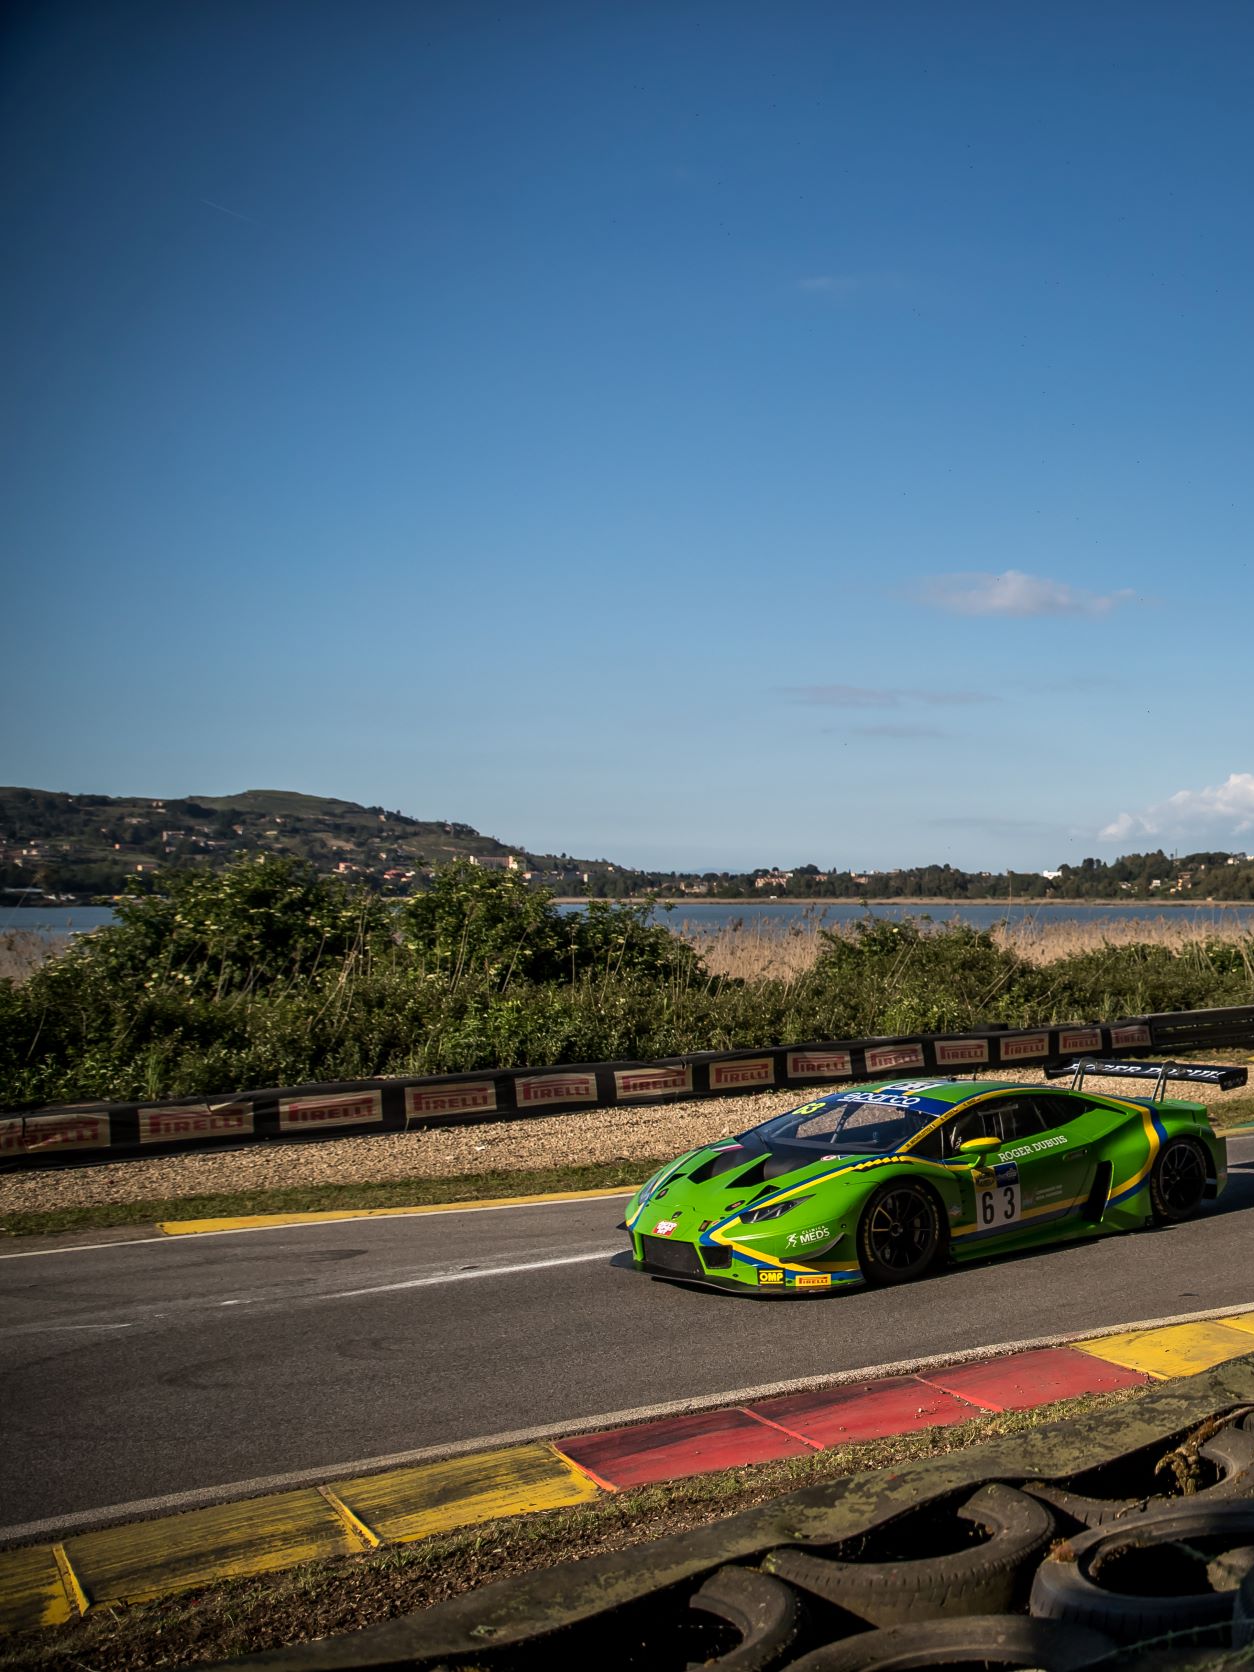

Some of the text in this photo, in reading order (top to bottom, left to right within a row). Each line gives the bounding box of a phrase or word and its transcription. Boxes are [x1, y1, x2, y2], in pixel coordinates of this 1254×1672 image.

[1005, 1038, 1045, 1056] PIRELLI
[1062, 1033, 1098, 1049] PIRELLI
[870, 1048, 922, 1067] PIRELLI
[940, 1044, 985, 1060] PIRELLI
[792, 1055, 846, 1073] PIRELLI
[622, 1070, 686, 1093] PIRELLI
[715, 1063, 769, 1084] PIRELLI
[523, 1078, 590, 1100] PIRELLI
[413, 1087, 488, 1112] PIRELLI
[843, 1091, 921, 1106] sparco
[287, 1096, 375, 1122] PIRELLI
[791, 1102, 827, 1115] 63
[149, 1108, 244, 1135] PIRELLI
[998, 1135, 1068, 1162] ROGER DUBUIS
[982, 1186, 1016, 1225] 63
[800, 1227, 831, 1244] MEDS
[759, 1272, 784, 1282] OMP
[798, 1276, 829, 1285] PIRELLI
